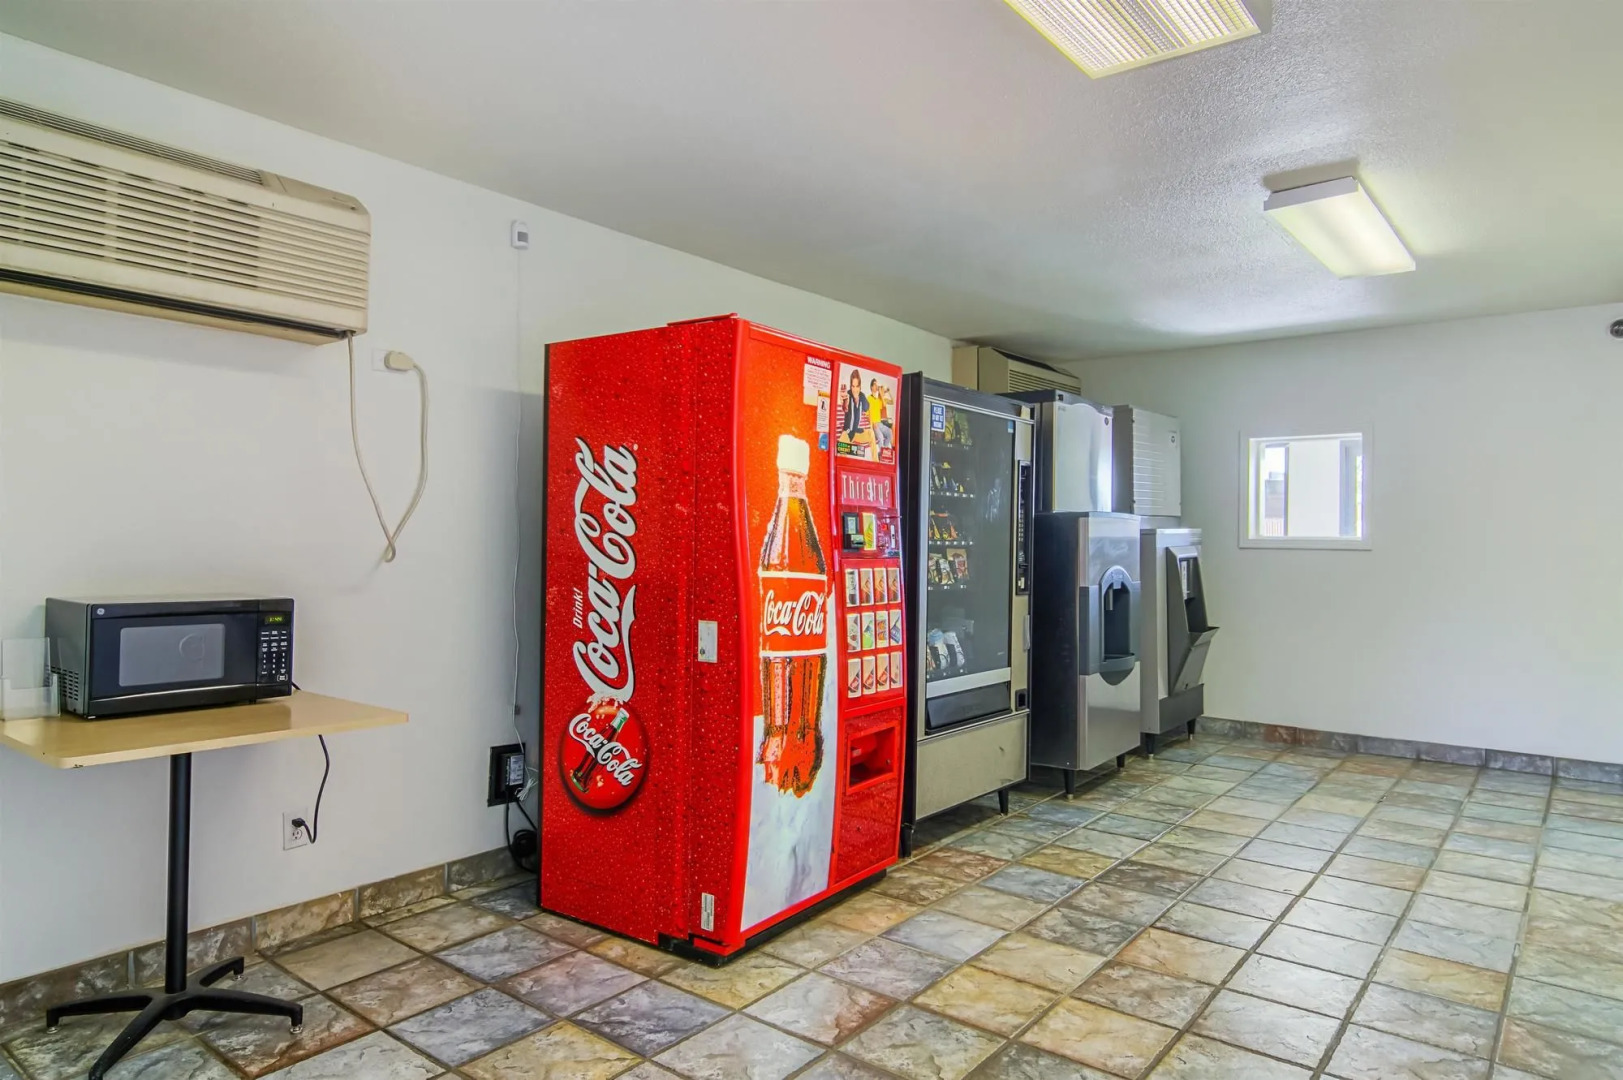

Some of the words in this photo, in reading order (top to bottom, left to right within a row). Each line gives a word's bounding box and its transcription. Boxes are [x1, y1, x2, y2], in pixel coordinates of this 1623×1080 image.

[807, 356, 831, 369] WARNING
[842, 474, 890, 506] Thirsty?
[573, 436, 638, 702] Coca-Cola
[573, 587, 583, 629] Drink!
[764, 589, 825, 636] Coca-Cola
[568, 712, 643, 788] Coca-Cola
